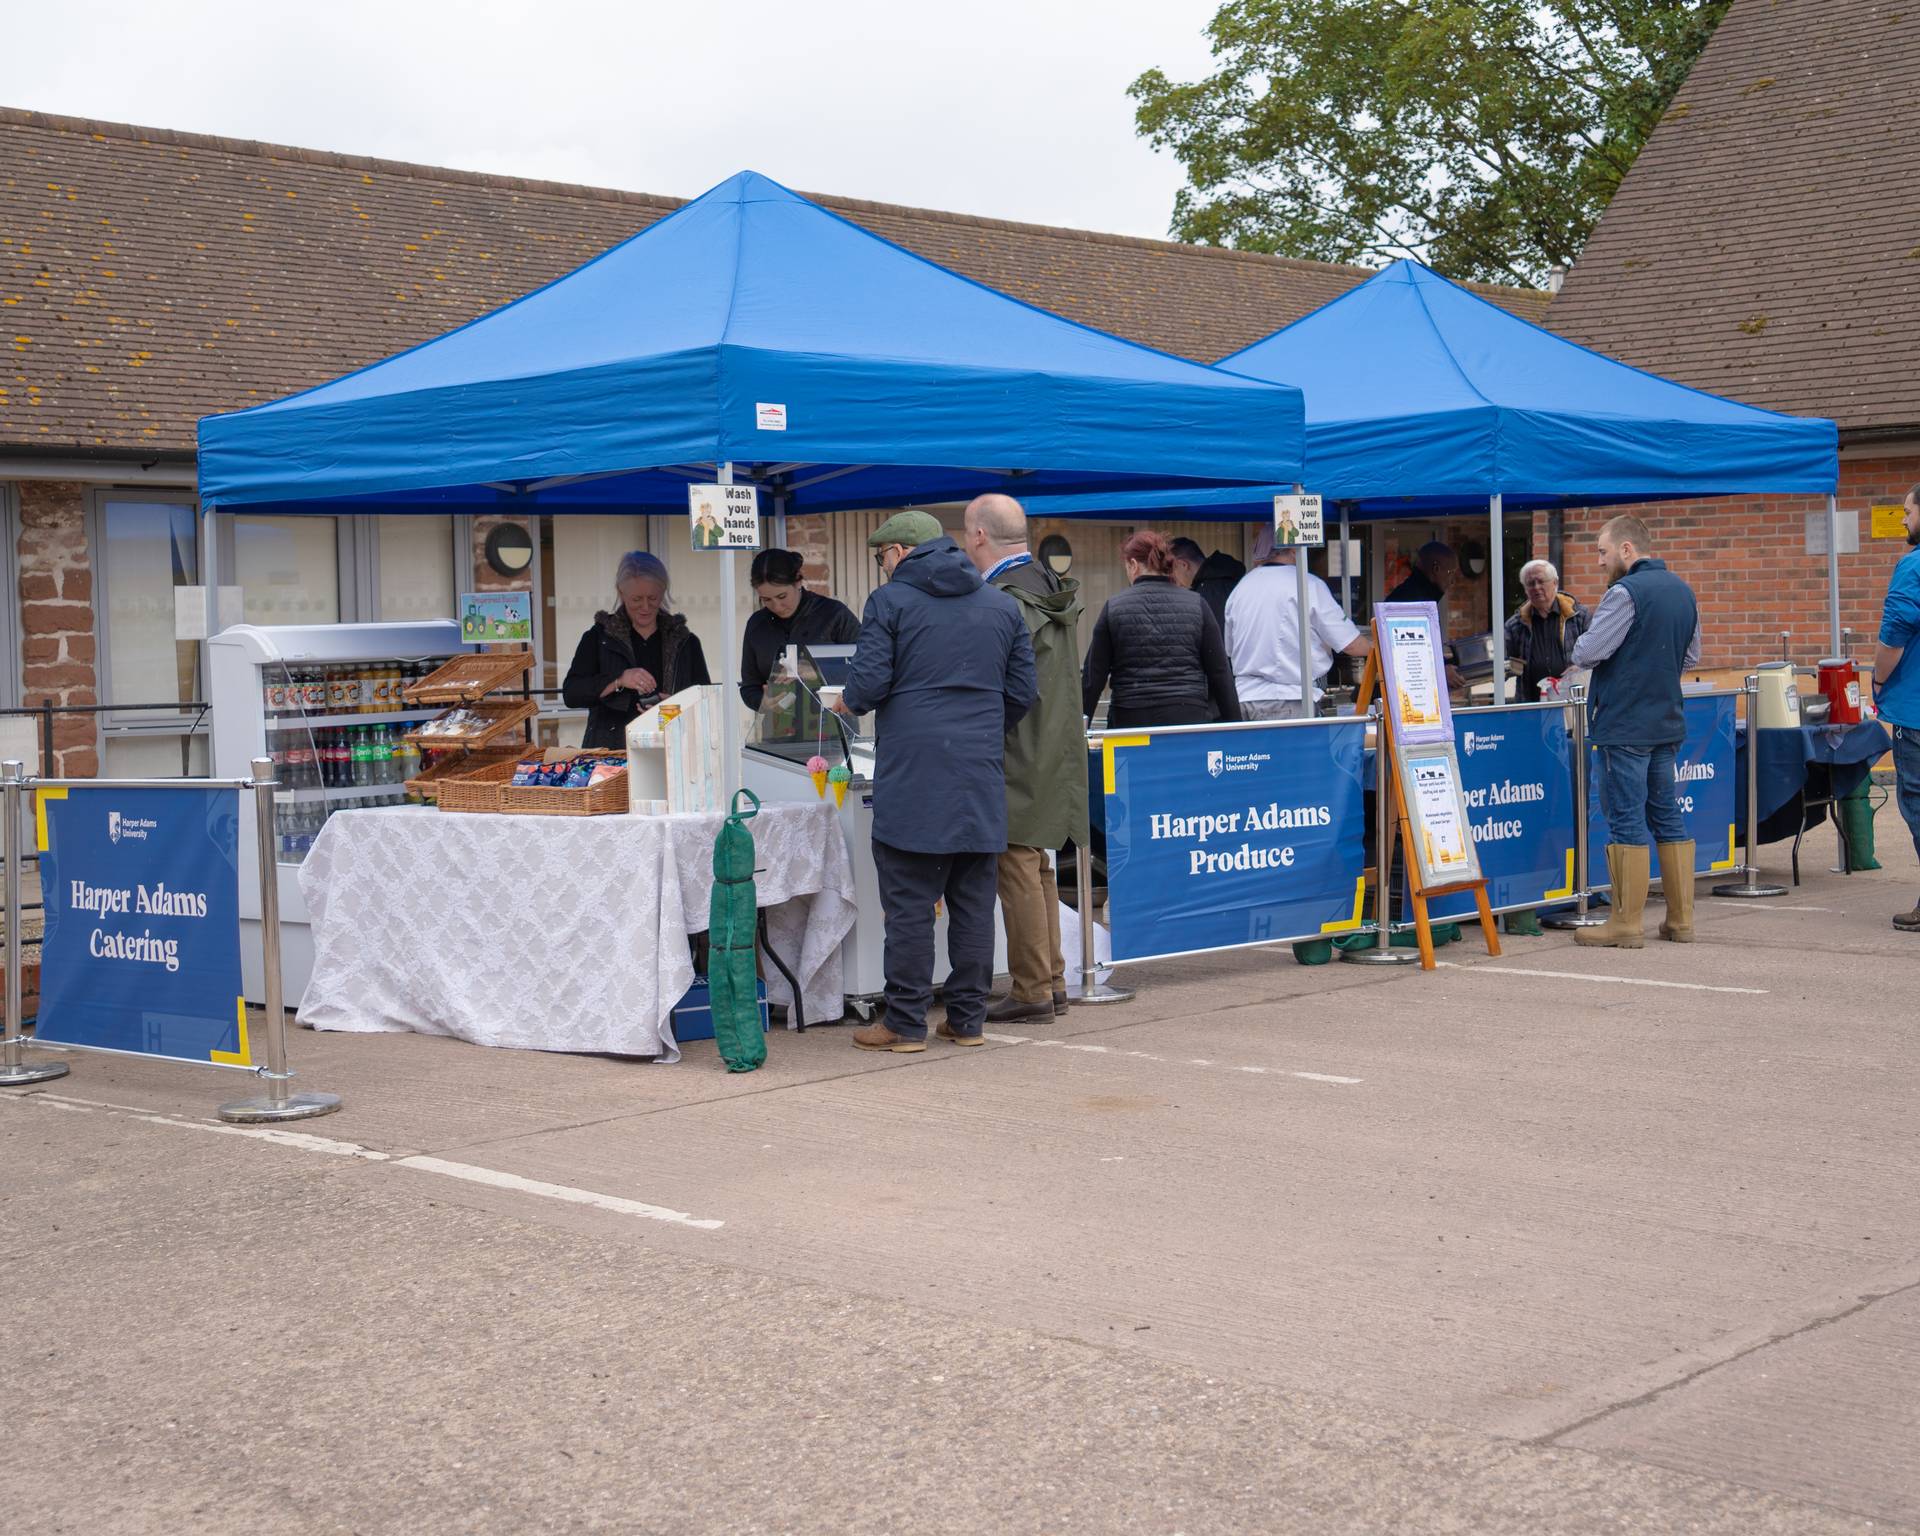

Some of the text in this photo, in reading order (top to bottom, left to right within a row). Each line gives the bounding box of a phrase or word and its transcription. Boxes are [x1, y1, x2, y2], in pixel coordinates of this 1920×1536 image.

[725, 488, 751, 499] Wash
[1300, 497, 1318, 505] Wash
[727, 504, 751, 516] your
[1301, 511, 1317, 519] your
[723, 517, 755, 529] hands
[1299, 520, 1320, 530] hands
[729, 532, 753, 543] here
[1302, 532, 1319, 541] here
[1225, 752, 1271, 764] Harper Adams
[1226, 762, 1259, 772] University
[1488, 779, 1545, 806] Adams
[1150, 802, 1331, 842] Harper Adams
[1472, 816, 1523, 843] oduce
[1189, 843, 1295, 875] Produce
[71, 879, 208, 919] Harper Adams
[89, 928, 180, 972] Catering
